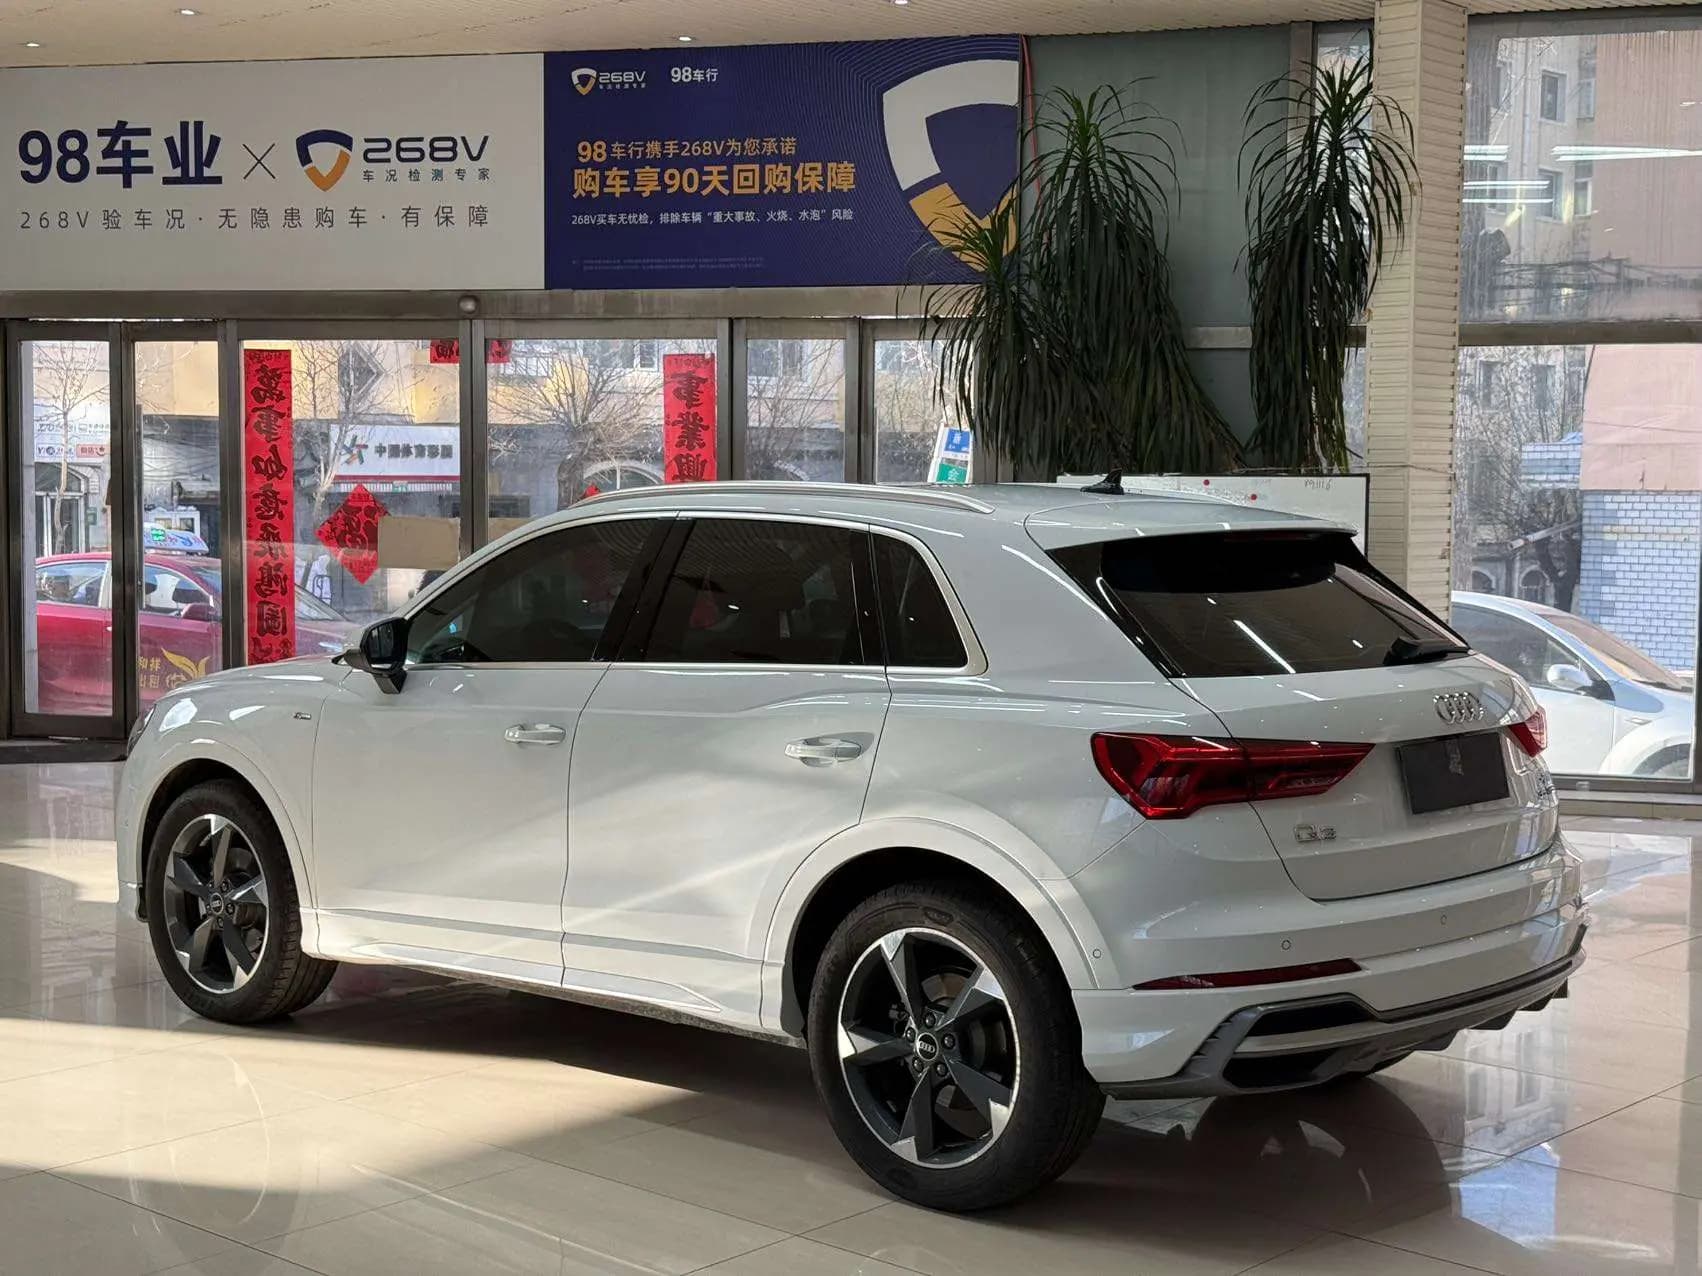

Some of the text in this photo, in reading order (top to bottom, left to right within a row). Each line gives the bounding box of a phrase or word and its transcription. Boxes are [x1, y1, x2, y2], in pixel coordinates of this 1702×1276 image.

[599, 71, 646, 83] 268V
[671, 67, 719, 83] 98车行
[18, 120, 223, 188] 98车业
[363, 135, 489, 163] 268V
[362, 167, 490, 182] 车况检测专家
[573, 161, 856, 199] 购车享90天回购保障
